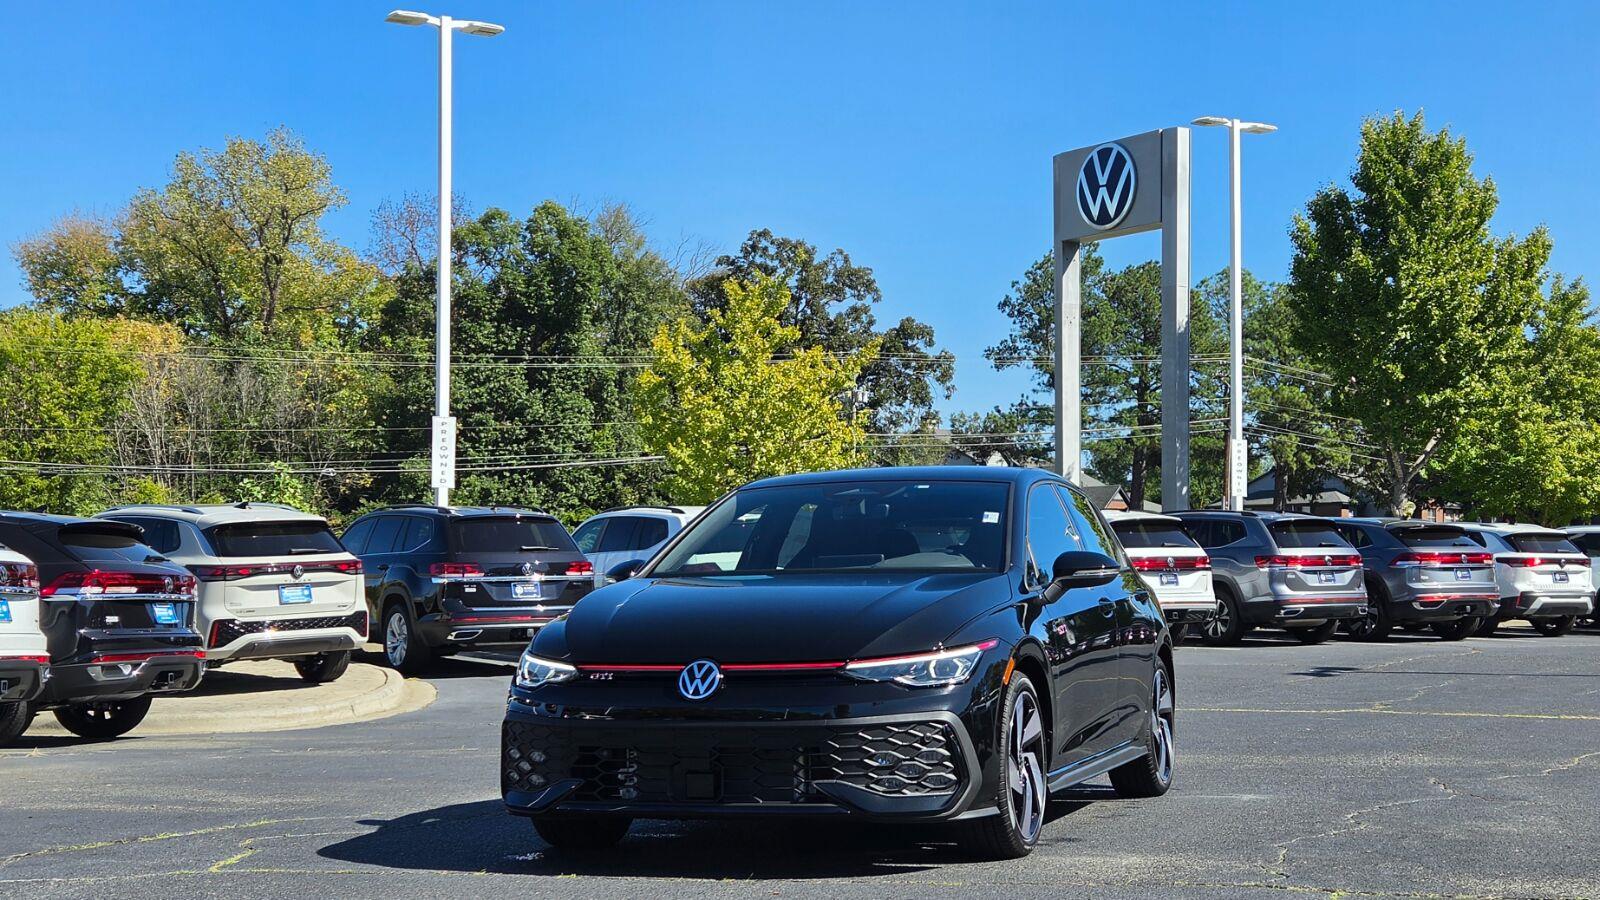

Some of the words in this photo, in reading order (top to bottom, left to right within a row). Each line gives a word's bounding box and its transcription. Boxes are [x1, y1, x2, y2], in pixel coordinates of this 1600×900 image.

[1076, 142, 1136, 230] VW
[439, 421, 448, 483] PREOWNED
[590, 672, 614, 680] GTI
[679, 660, 720, 699] VW
